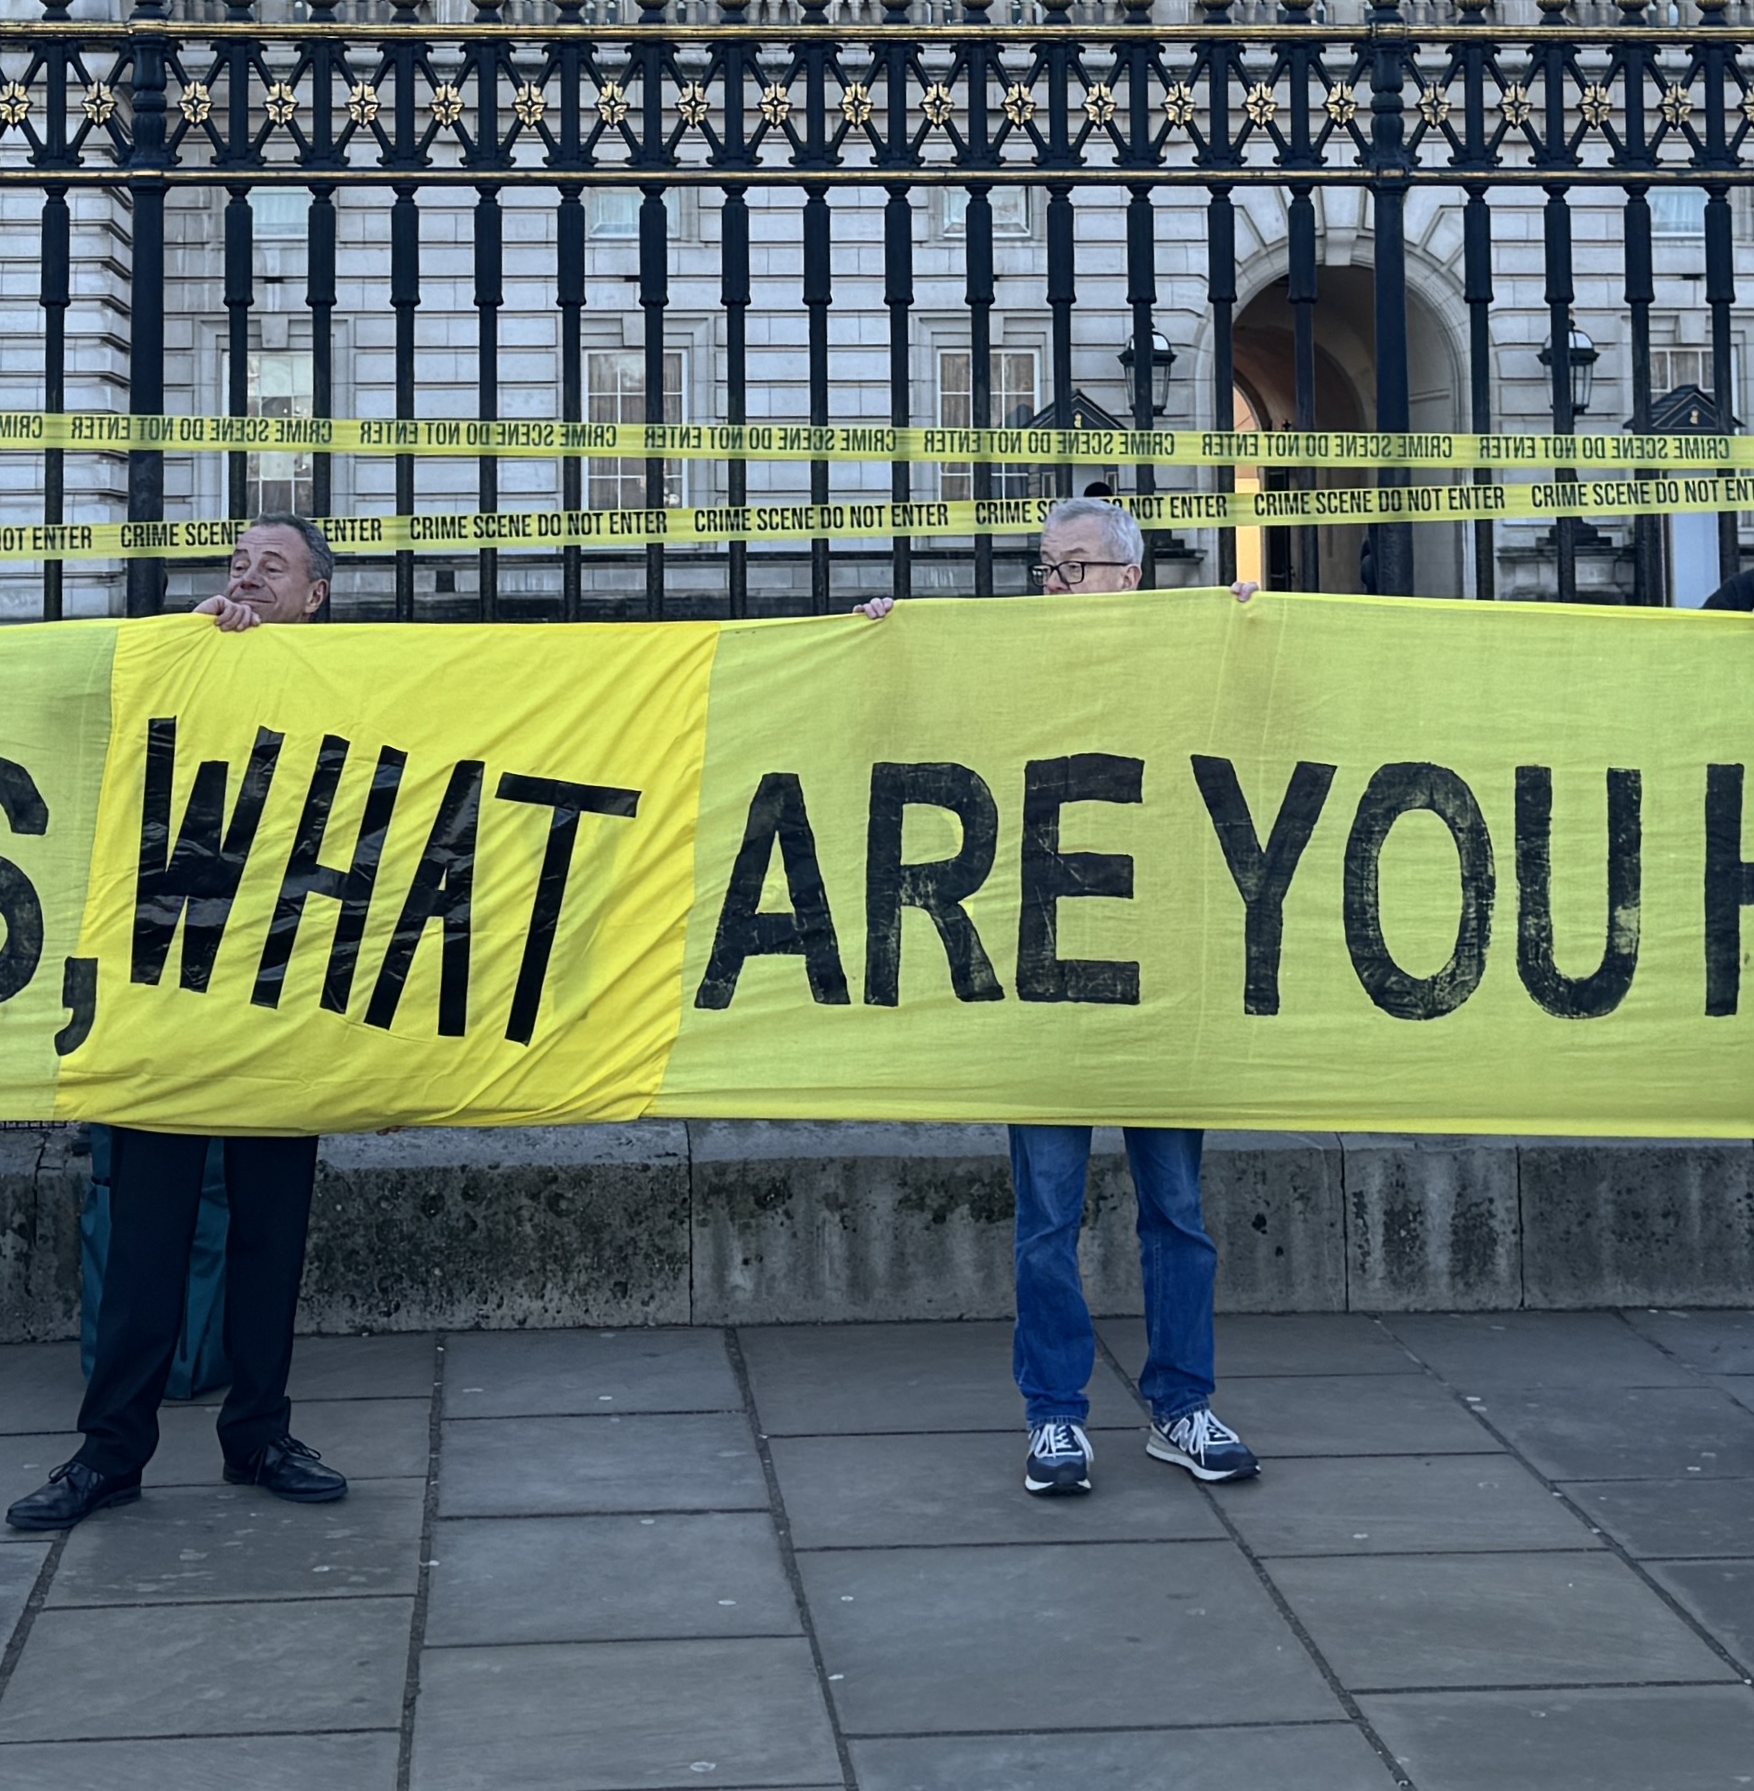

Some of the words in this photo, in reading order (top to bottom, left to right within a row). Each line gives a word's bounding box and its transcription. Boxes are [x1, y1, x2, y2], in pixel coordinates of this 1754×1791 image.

[1255, 493, 1310, 517] CRIME
[1317, 491, 1372, 514] SCENE
[1379, 490, 1402, 512] DO
[1408, 489, 1442, 512] NOT
[1449, 487, 1504, 510] ENTER
[1532, 484, 1588, 507] CRIME
[1594, 482, 1650, 506] SCENE
[1657, 480, 1679, 503] DO
[1686, 480, 1718, 502] NOT
[695, 508, 751, 532] CRIME
[757, 507, 815, 531] SCENE
[821, 506, 844, 529] DO
[851, 506, 885, 528] NOT
[892, 504, 948, 526] ENTER
[976, 501, 1031, 525] CRIME
[1129, 496, 1164, 520] NOT
[1170, 495, 1227, 518] ENTER
[33, 527, 91, 550] ENTER
[121, 524, 179, 548] CRIME
[324, 519, 381, 542] ENTER
[411, 516, 467, 539] CRIME
[474, 515, 531, 538] SCENE
[538, 514, 561, 536] DO
[568, 512, 603, 535] NOT
[610, 511, 667, 534] ENTER
[130, 715, 641, 1047] WHAT
[694, 753, 1143, 1009] ARE
[1190, 754, 1642, 1022] YOU
